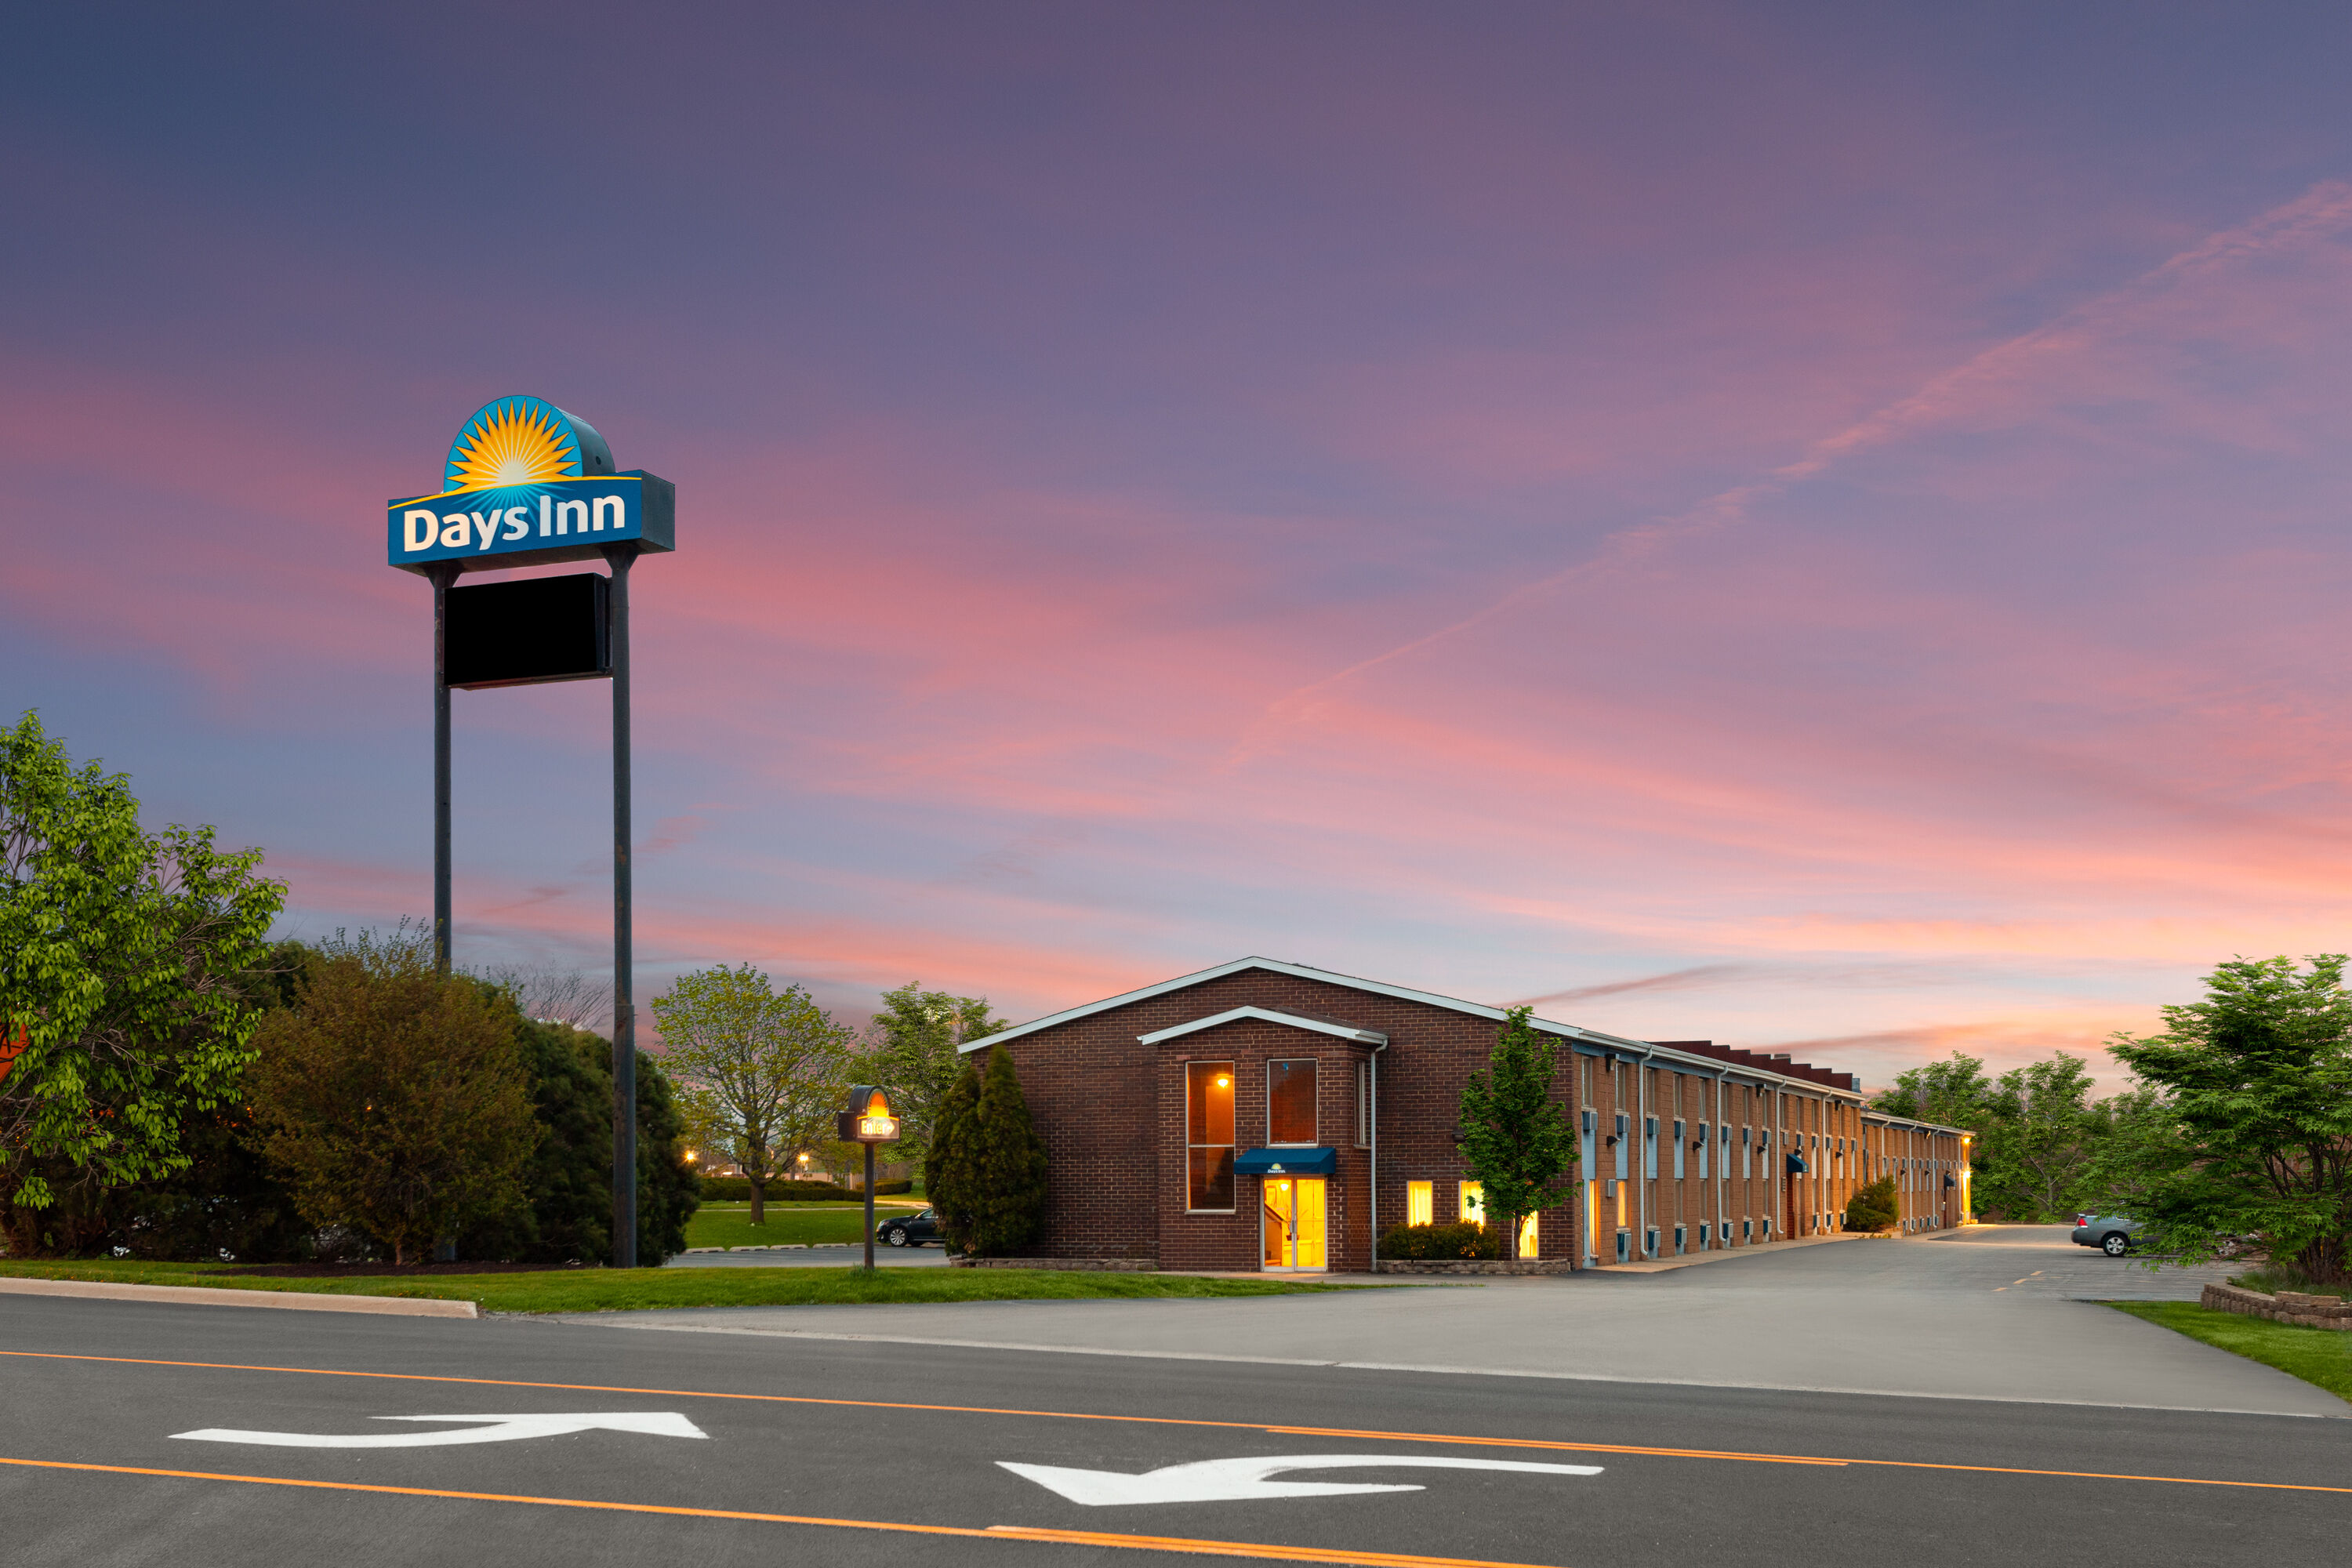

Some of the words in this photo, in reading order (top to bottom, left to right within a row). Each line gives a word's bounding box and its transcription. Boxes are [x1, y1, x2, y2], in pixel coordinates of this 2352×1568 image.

[404, 506, 529, 552] Days
[539, 495, 625, 537] Inn
[861, 1120, 887, 1134] Enter
